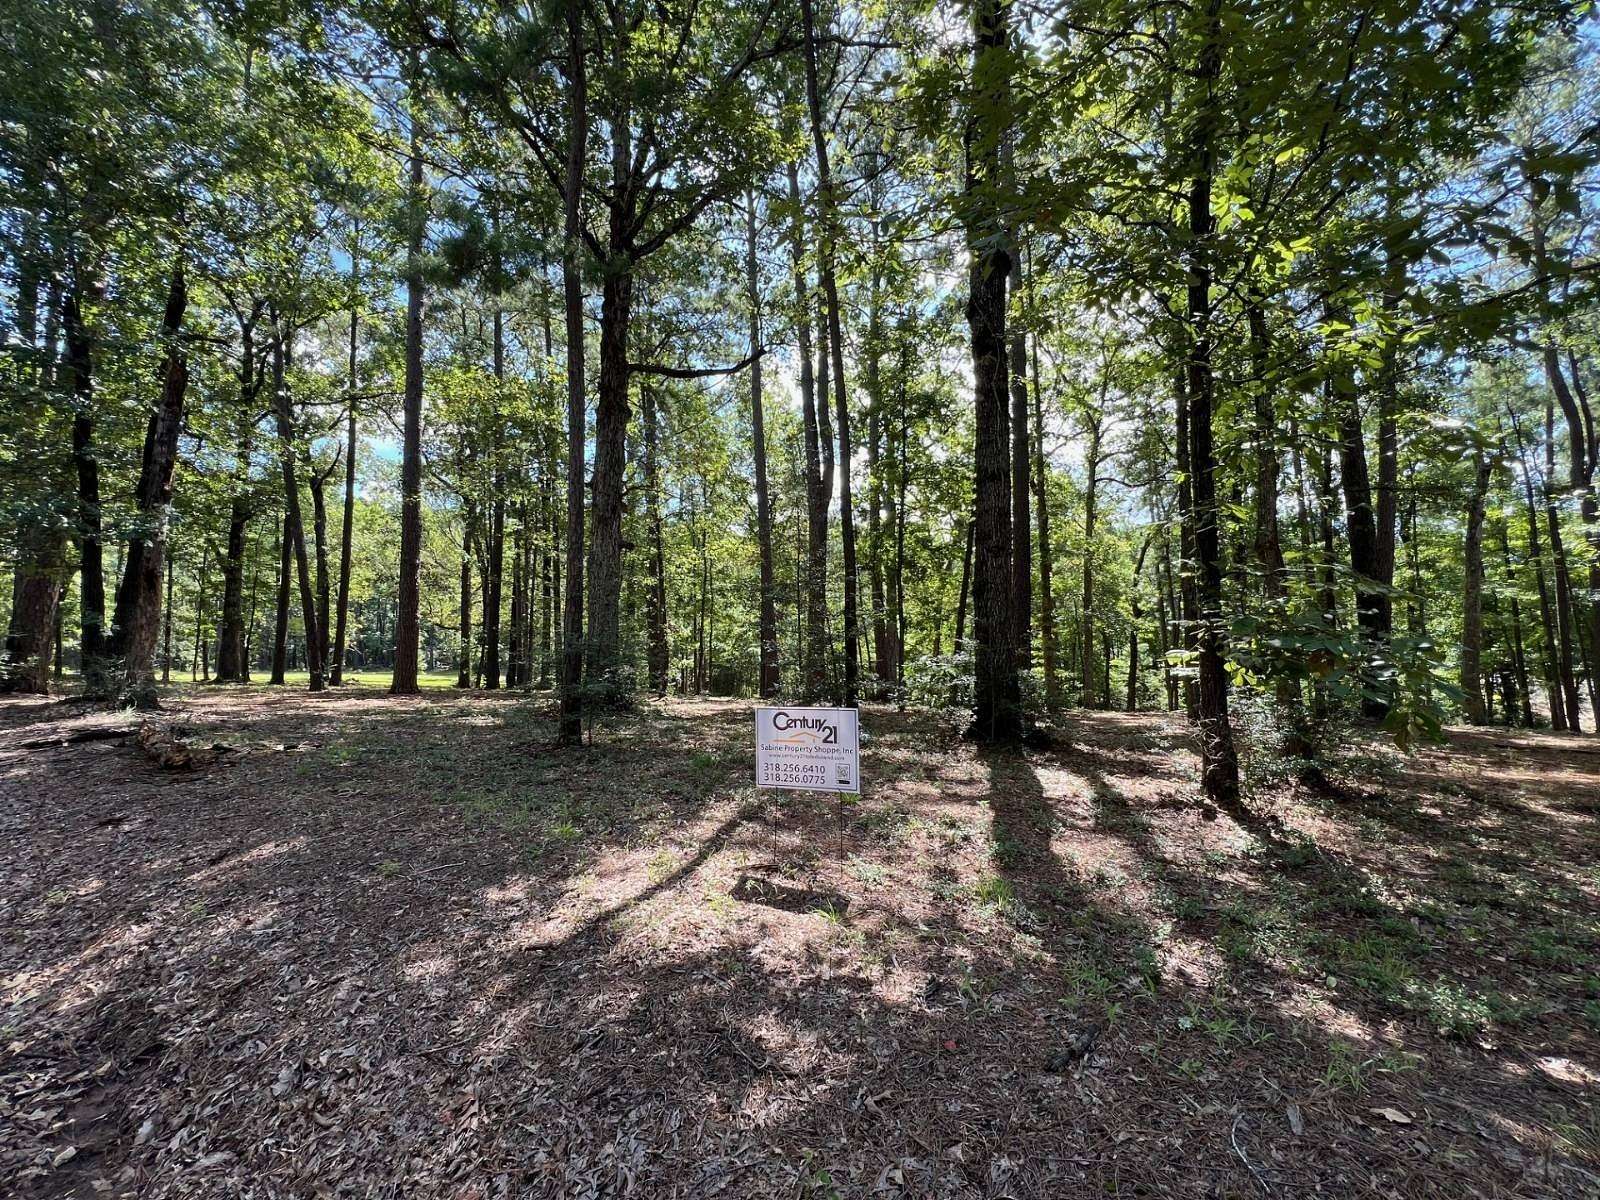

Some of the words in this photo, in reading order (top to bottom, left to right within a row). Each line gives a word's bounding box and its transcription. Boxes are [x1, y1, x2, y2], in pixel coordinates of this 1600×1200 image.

[773, 712, 826, 732] Century
[822, 726, 837, 744] 21
[761, 744, 783, 752] Sabine
[784, 745, 812, 753] Property
[764, 763, 826, 774] 318.256.6410
[764, 772, 826, 784] 318.256.0775
